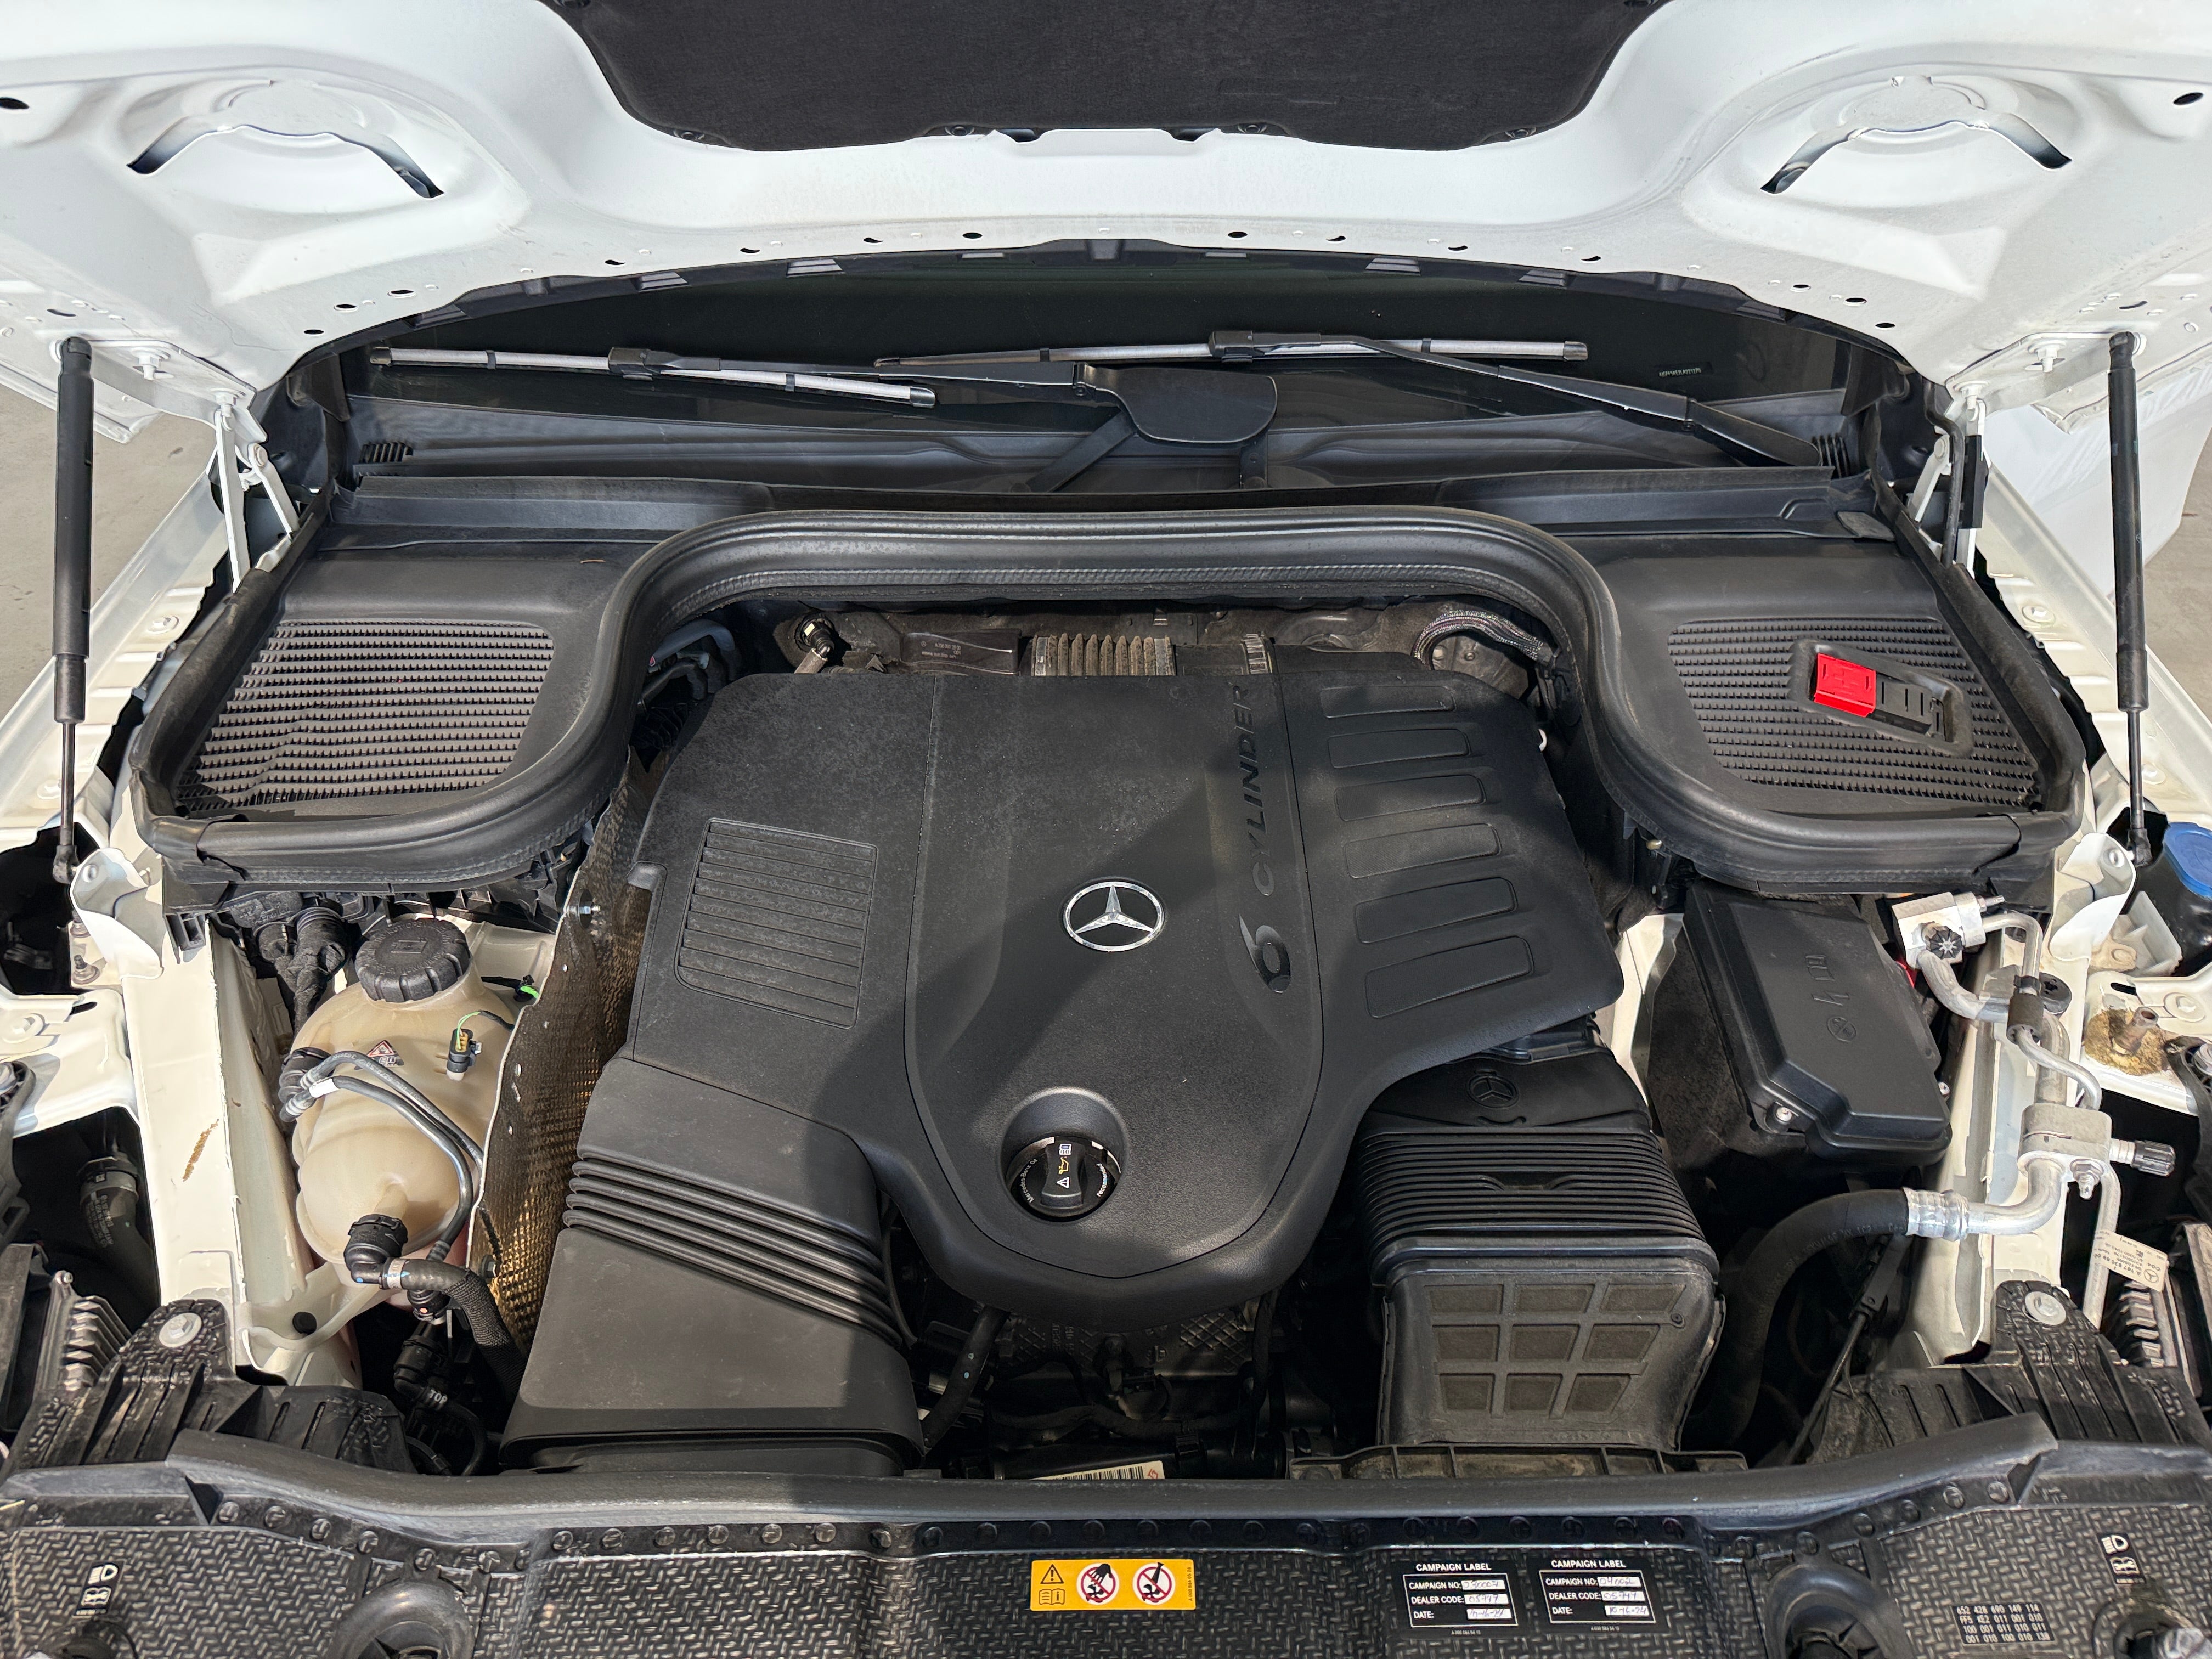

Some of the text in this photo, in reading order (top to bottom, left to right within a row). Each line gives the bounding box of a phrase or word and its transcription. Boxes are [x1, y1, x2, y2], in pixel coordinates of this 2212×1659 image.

[1231, 684, 1291, 994] 6 CYLINDER
[1020, 1165, 1034, 1203] Mercedes-Benz
[1096, 1163, 1108, 1197] recommended
[428, 1388, 448, 1404] TOP
[1415, 1562, 1492, 1572] CAMPAIGN LABEL
[1551, 1560, 1627, 1568] CAMPAIGN LABEL
[1410, 1595, 1465, 1604] DEALER CODE:
[1548, 1592, 1602, 1600] DEALER CODE:
[1413, 1611, 1435, 1619] DATE:
[1552, 1606, 1573, 1615] DATE:
[1994, 1614, 2008, 1623] 011
[2011, 1613, 2025, 1623] 001
[2028, 1613, 2044, 1622] 010
[1963, 1623, 2046, 1634] 100 001 011 010 011
[1966, 1634, 1980, 1643] 001
[1983, 1634, 1998, 1643] 010
[2001, 1633, 2016, 1642] 100
[2018, 1633, 2033, 1641] 010
